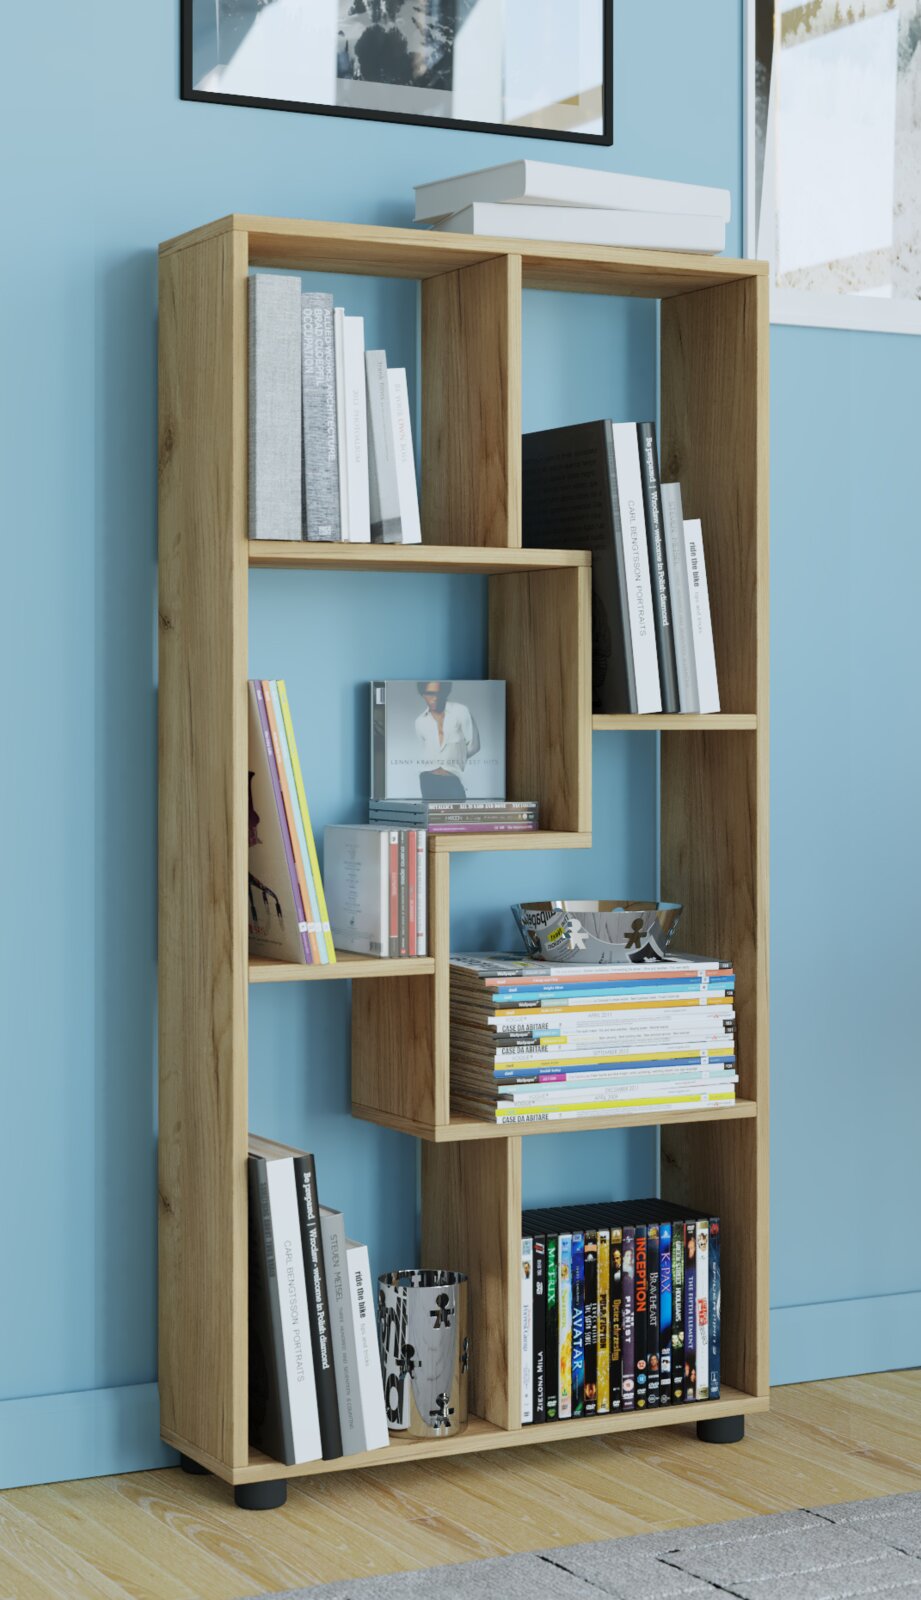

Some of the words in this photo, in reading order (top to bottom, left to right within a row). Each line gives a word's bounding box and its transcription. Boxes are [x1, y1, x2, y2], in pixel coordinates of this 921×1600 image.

[315, 309, 323, 337] BRAD
[324, 309, 333, 344] ALLIED
[303, 309, 314, 373] OCCUPATION
[315, 339, 325, 386] CLOEPFIL
[325, 347, 333, 381] WORKS
[325, 384, 336, 462] ARCHITECTURE
[646, 437, 653, 447] Be
[645, 448, 656, 483] prepared
[627, 500, 637, 522] CARL
[630, 526, 642, 582] BENGTSSON
[654, 528, 663, 562] welcome
[689, 542, 698, 557] ride
[691, 557, 699, 570] the
[692, 571, 700, 587] bike
[657, 570, 666, 593] Polish
[635, 585, 647, 637] PORTRAITS
[502, 1024, 517, 1032] CASE
[525, 1022, 549, 1030] ABITARE
[501, 1047, 516, 1055] CASE
[517, 1046, 525, 1054] DA
[525, 1045, 549, 1053] ABITARE
[502, 1116, 516, 1124] CASE
[517, 1115, 525, 1123] DA
[525, 1114, 549, 1122] ABITARE
[303, 1171, 311, 1183] Be
[302, 1184, 316, 1220] prepared
[284, 1240, 293, 1264] CARL
[330, 1233, 340, 1267] STEVEN
[312, 1267, 323, 1303] welcome
[334, 1271, 344, 1303] MEISEL
[355, 1271, 364, 1287] ride
[548, 1247, 556, 1304] MATRIX
[635, 1237, 647, 1312] INCEPTION
[661, 1252, 671, 1294] K-PAX
[286, 1267, 299, 1325] BENGTSSON
[356, 1287, 366, 1301] the
[358, 1302, 367, 1319] bike
[649, 1272, 659, 1327] BRAVEHEART
[317, 1310, 327, 1334] Polish
[572, 1307, 583, 1371] AVATAR
[292, 1329, 304, 1383] PORTRAITS
